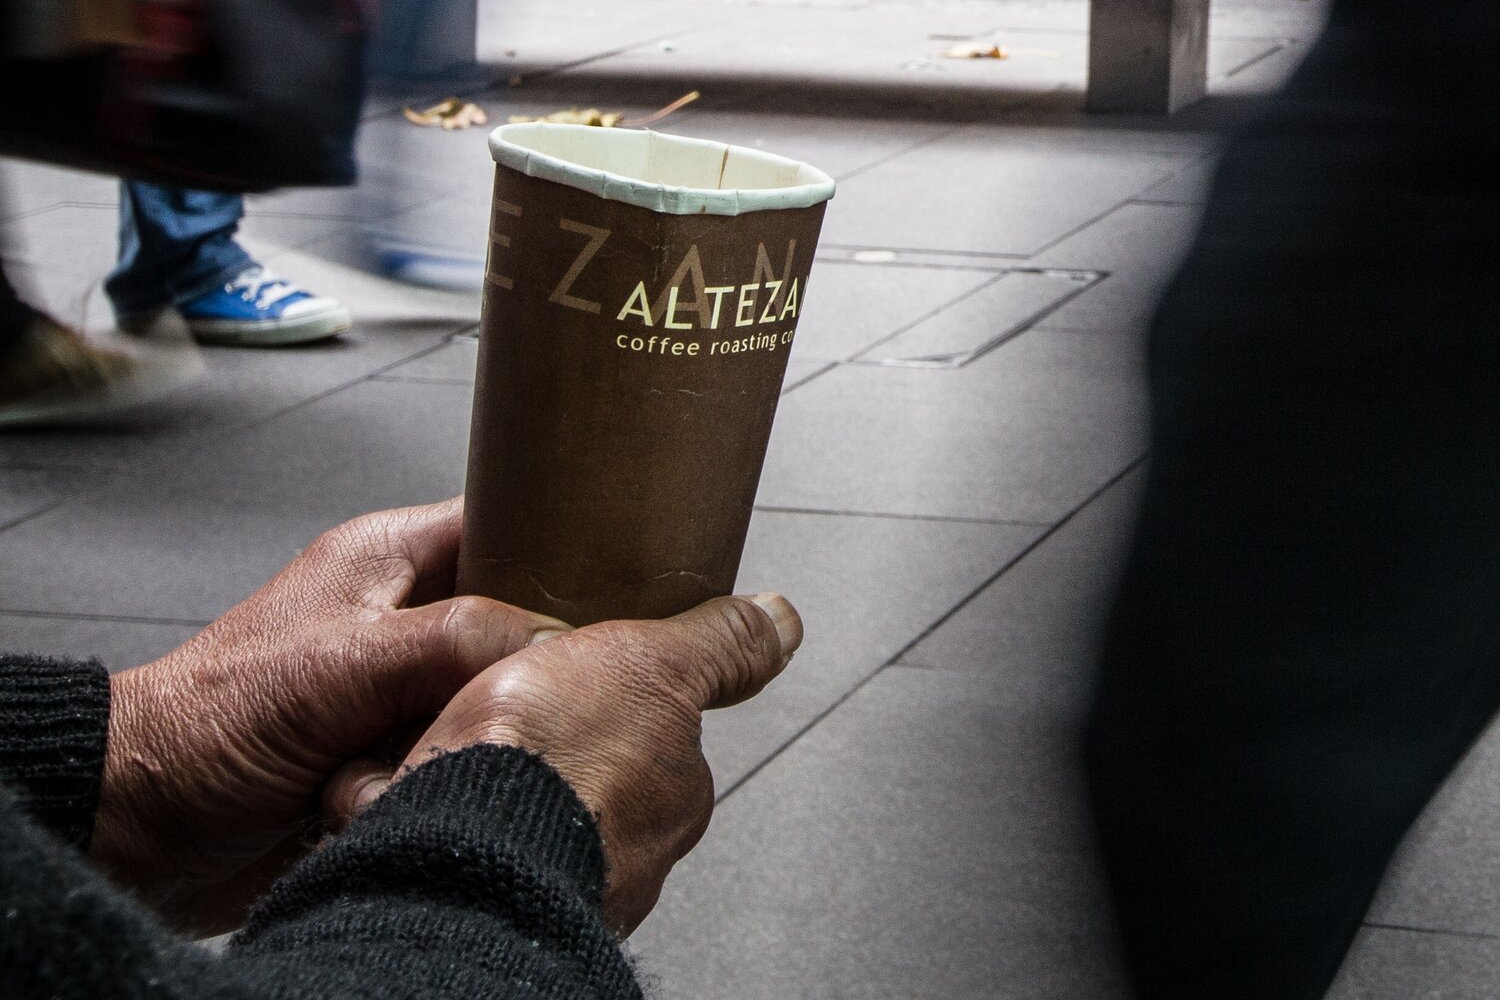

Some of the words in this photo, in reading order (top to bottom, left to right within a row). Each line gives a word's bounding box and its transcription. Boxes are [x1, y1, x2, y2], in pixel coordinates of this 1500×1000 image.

[616, 334, 700, 356] coffee
[710, 331, 777, 355] roasting
[781, 328, 796, 346] co
